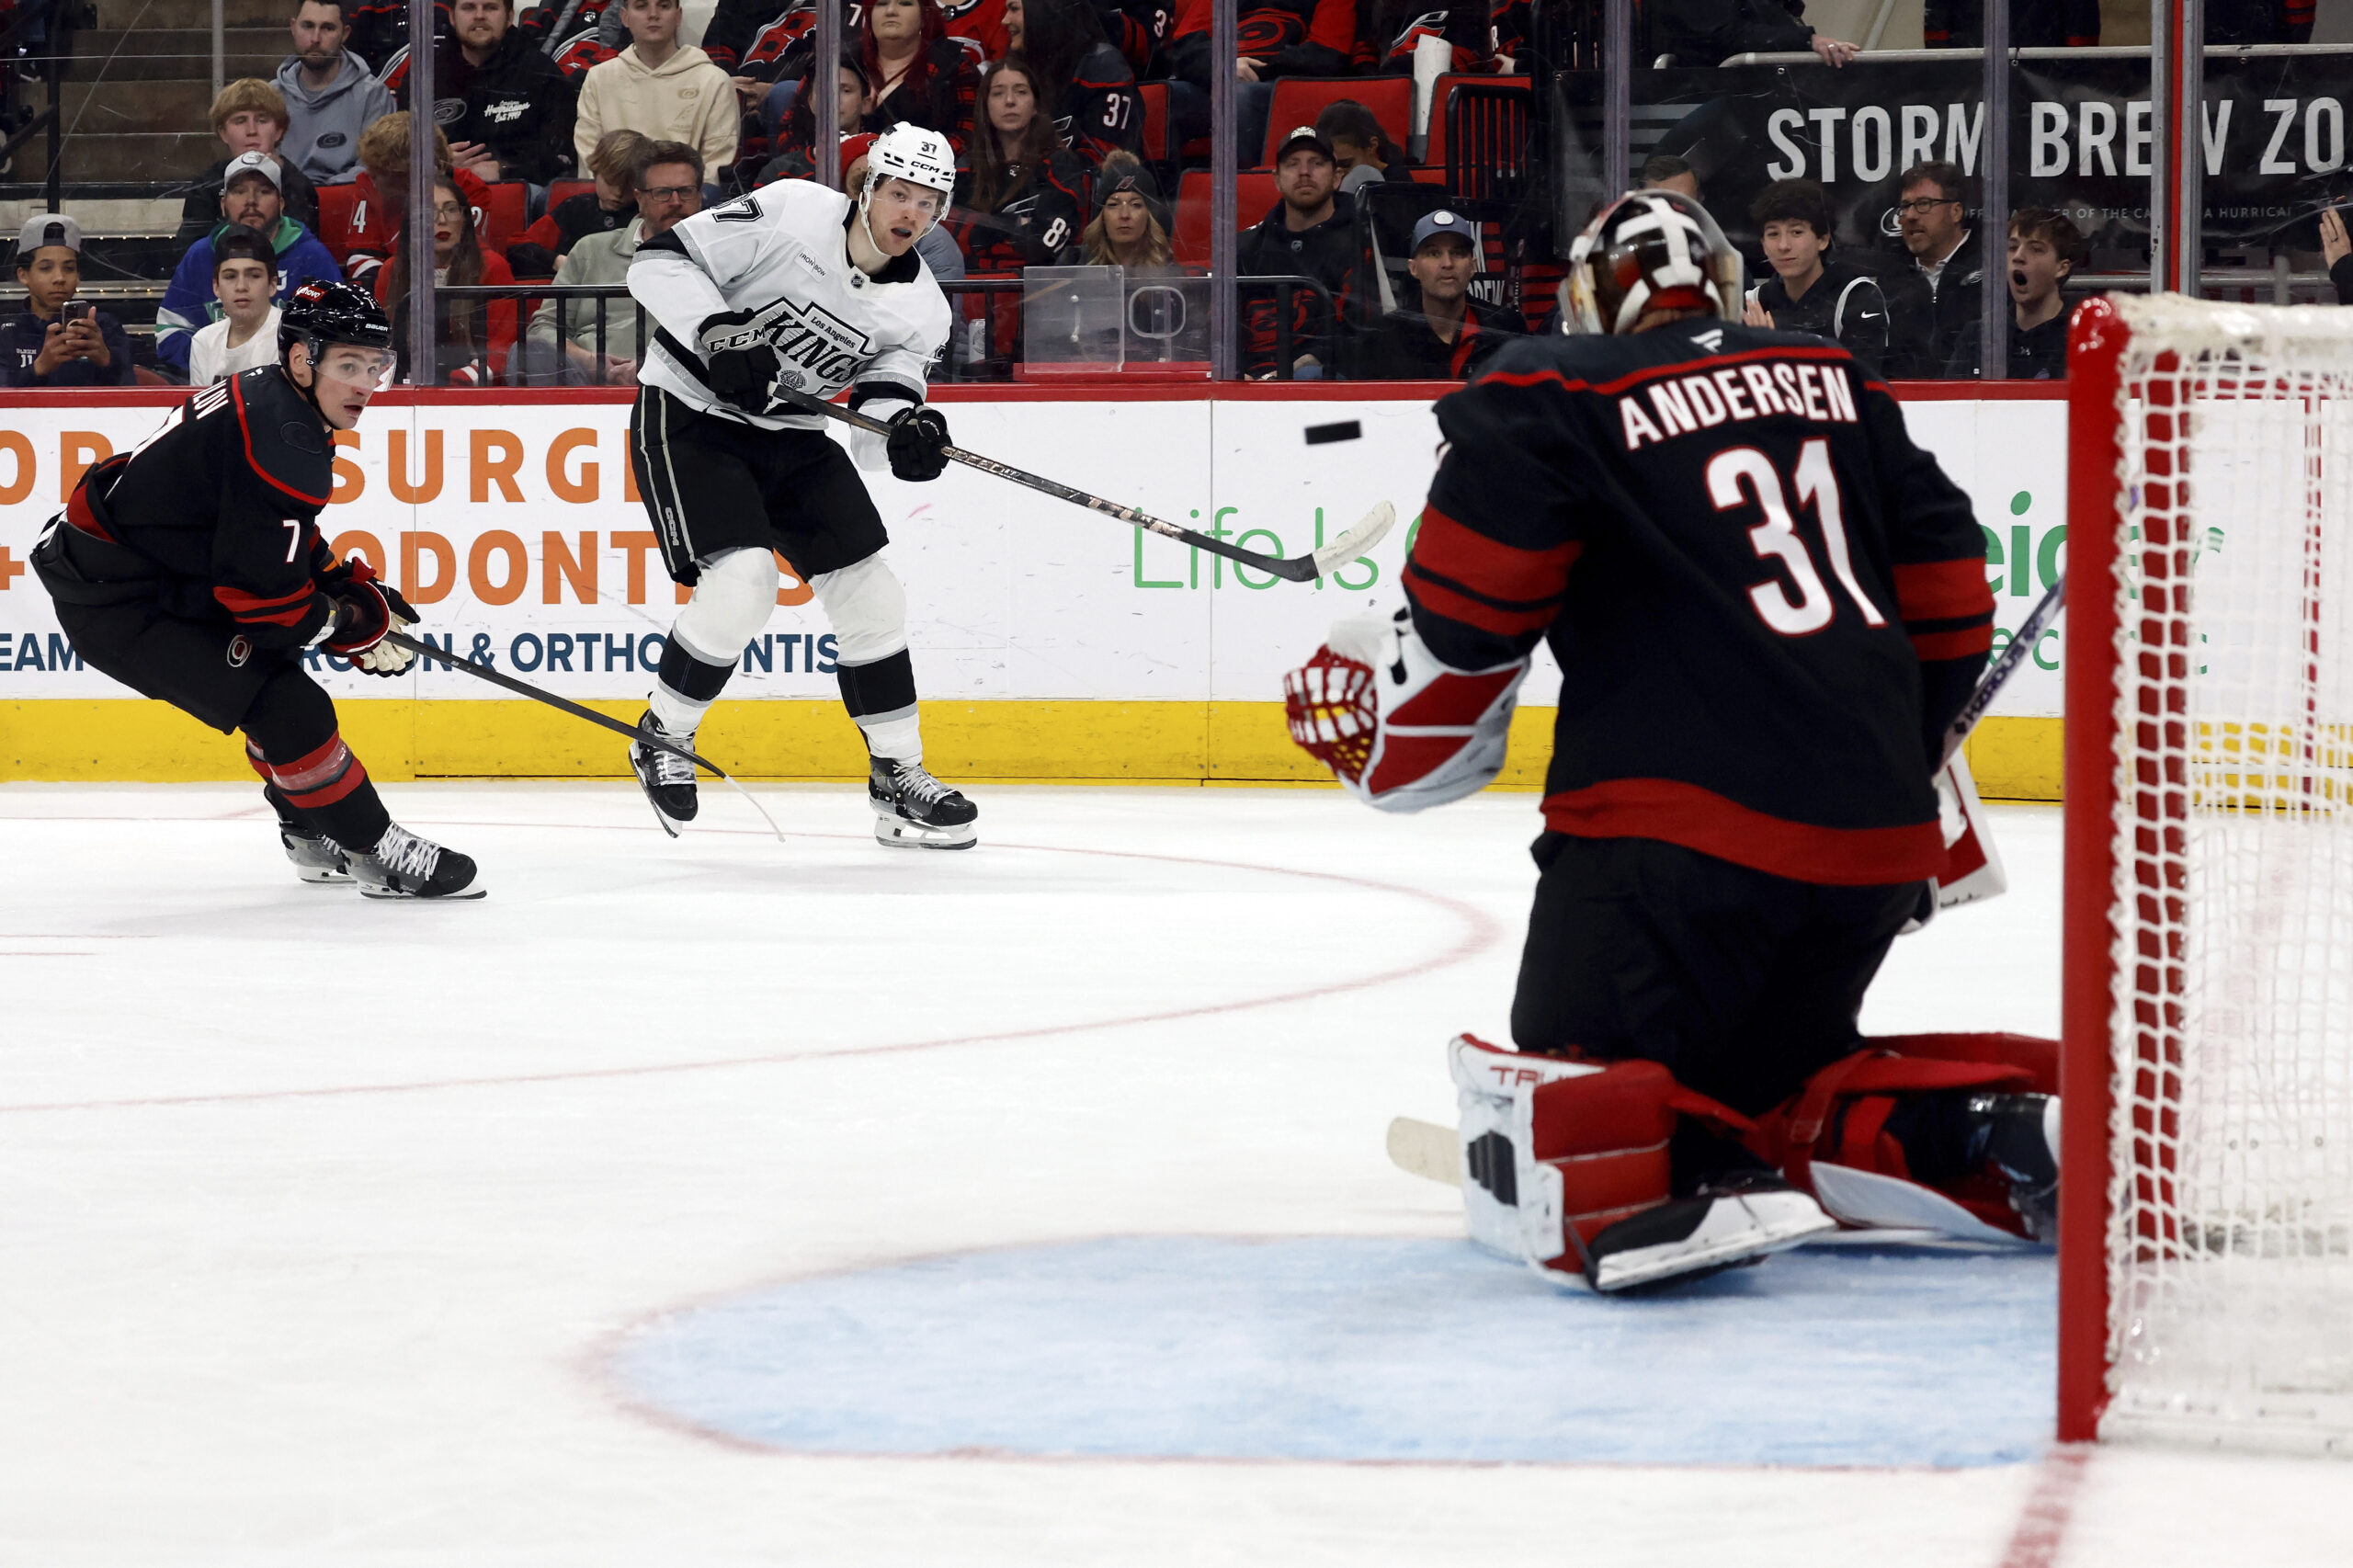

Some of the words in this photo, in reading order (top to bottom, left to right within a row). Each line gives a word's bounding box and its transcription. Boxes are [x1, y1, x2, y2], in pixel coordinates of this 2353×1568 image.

[1103, 93, 1131, 131] 37
[921, 141, 938, 155] 37
[1767, 101, 1984, 184] STORM
[910, 160, 940, 174] CCM
[352, 199, 368, 234] 4
[710, 192, 765, 222] 7
[798, 252, 815, 267] IRON
[813, 264, 827, 278] BOW
[365, 323, 389, 332] BAUER
[709, 326, 767, 353] CCM
[811, 316, 825, 330] Los
[824, 325, 857, 349] Angeles
[764, 311, 871, 382] KINGS
[1618, 361, 1859, 451] ANDERSEN
[282, 519, 301, 562] 7
[665, 506, 680, 546] CCM
[1704, 437, 1888, 637] 31
[1133, 506, 1284, 590] Life
